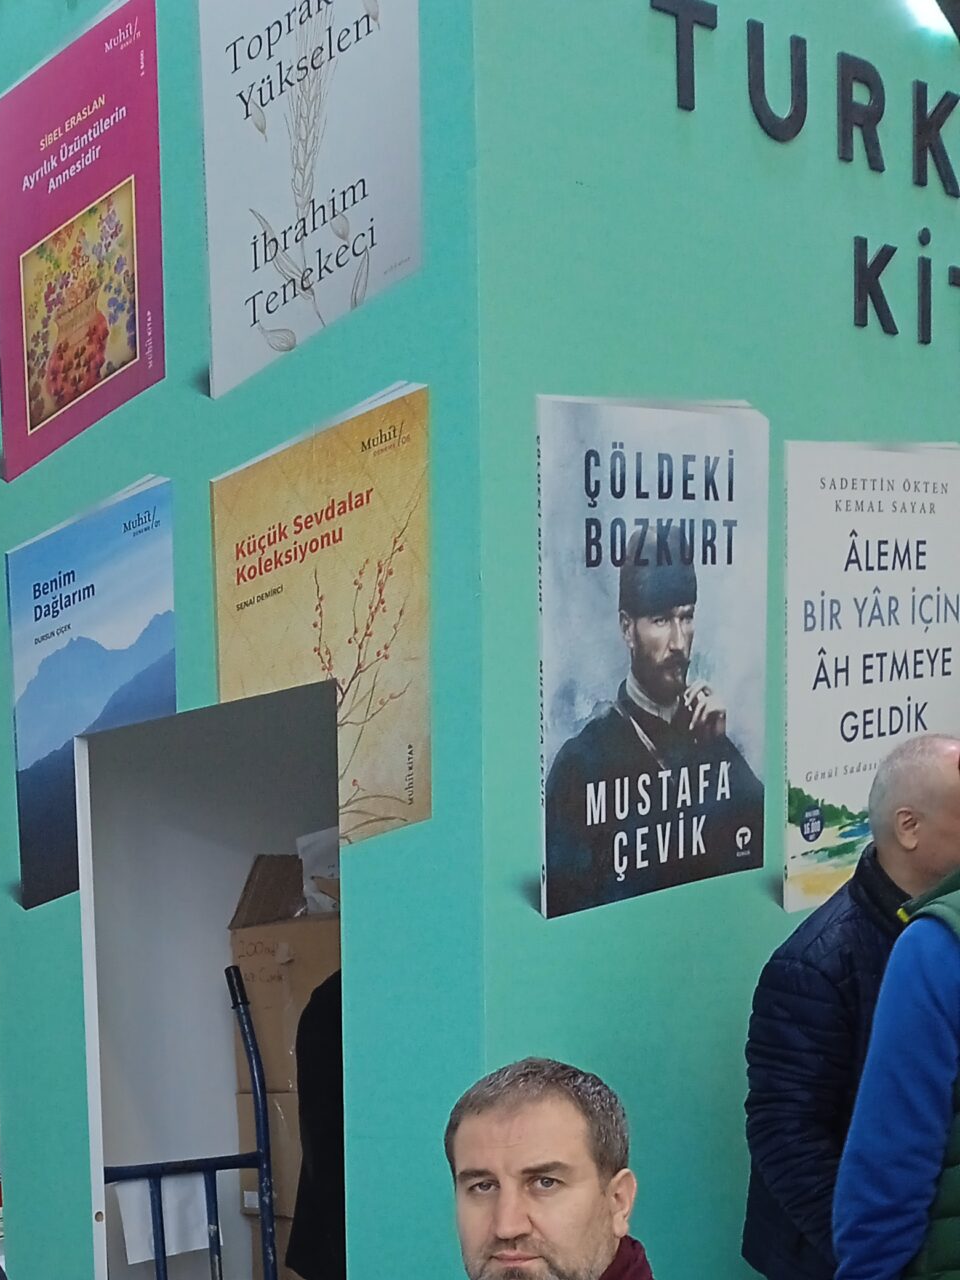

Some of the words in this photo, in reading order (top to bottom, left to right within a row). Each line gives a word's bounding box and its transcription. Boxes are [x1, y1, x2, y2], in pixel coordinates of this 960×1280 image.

[236, 14, 373, 120] Yükselen
[22, 156, 58, 191] Ayrılık
[59, 104, 127, 163] Üzüntülerin
[39, 127, 63, 151] SİBEL
[64, 94, 106, 133] ERASLAN
[47, 145, 101, 194] Annesidir
[250, 177, 369, 273] İbrahim
[244, 217, 378, 328] Tenekeci
[584, 441, 734, 508] ÇÖLDEKİ
[819, 477, 895, 491] SADETTİN
[902, 478, 949, 494] ÖKTEN
[235, 521, 288, 561] Küçük
[292, 488, 374, 535] Sevdalar
[835, 499, 884, 513] KEMAL
[892, 501, 936, 514] SAYAR
[235, 526, 343, 586] Koleksiyonu
[585, 517, 738, 568] BOZKURT
[844, 528, 927, 572] ÂLEME
[32, 569, 76, 600] Benim
[34, 583, 96, 622] Dağlarım
[803, 590, 842, 632] BİR
[853, 586, 900, 628] YÂR
[911, 586, 960, 633] İÇİN
[812, 646, 849, 691] ÂH
[862, 647, 952, 686] ETMEYE
[840, 696, 928, 743] GELDİK
[586, 760, 731, 826] MUSTAFA
[613, 811, 707, 882] ÇEVİK
